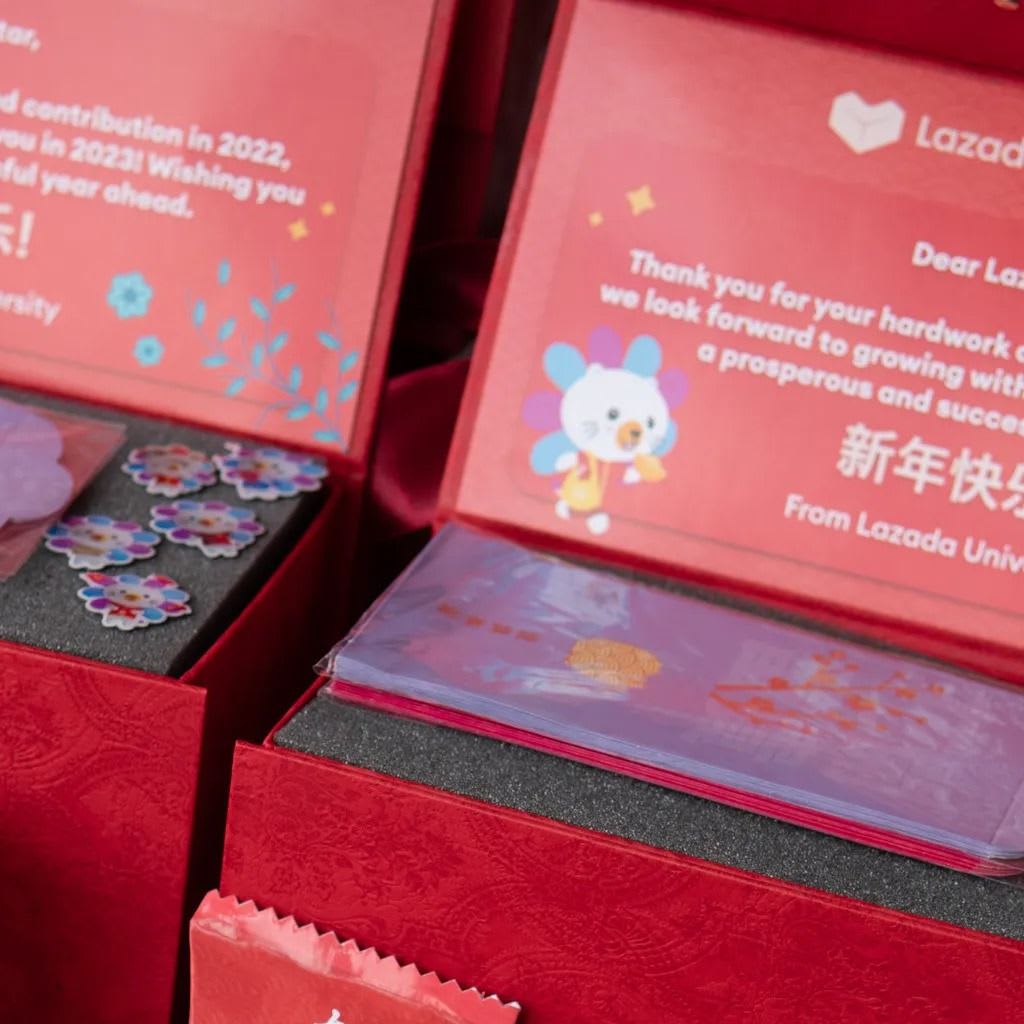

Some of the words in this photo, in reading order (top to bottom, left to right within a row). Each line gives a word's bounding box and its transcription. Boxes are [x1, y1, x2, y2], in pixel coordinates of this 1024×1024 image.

[22, 97, 184, 148] contribution
[187, 124, 214, 153] in
[216, 131, 292, 172] 2022,
[40, 129, 66, 157] in
[69, 136, 144, 174] 2023!
[148, 153, 252, 201] Wishing
[255, 179, 306, 206] you
[40, 170, 101, 197] year
[103, 181, 194, 219] ahead.
[912, 240, 982, 278] Dear
[600, 283, 640, 309] we
[643, 287, 702, 324] look
[706, 302, 816, 350] forward
[819, 332, 849, 357] to
[852, 344, 965, 390] growing
[630, 249, 711, 290] Thank
[714, 274, 765, 303] you
[769, 280, 812, 312] for
[812, 297, 876, 327] your
[878, 304, 1012, 361] hardwork
[697, 342, 717, 363] a
[719, 348, 873, 400] prosperous
[877, 385, 934, 414] and
[784, 493, 851, 535] From
[855, 511, 958, 558] Lazada
